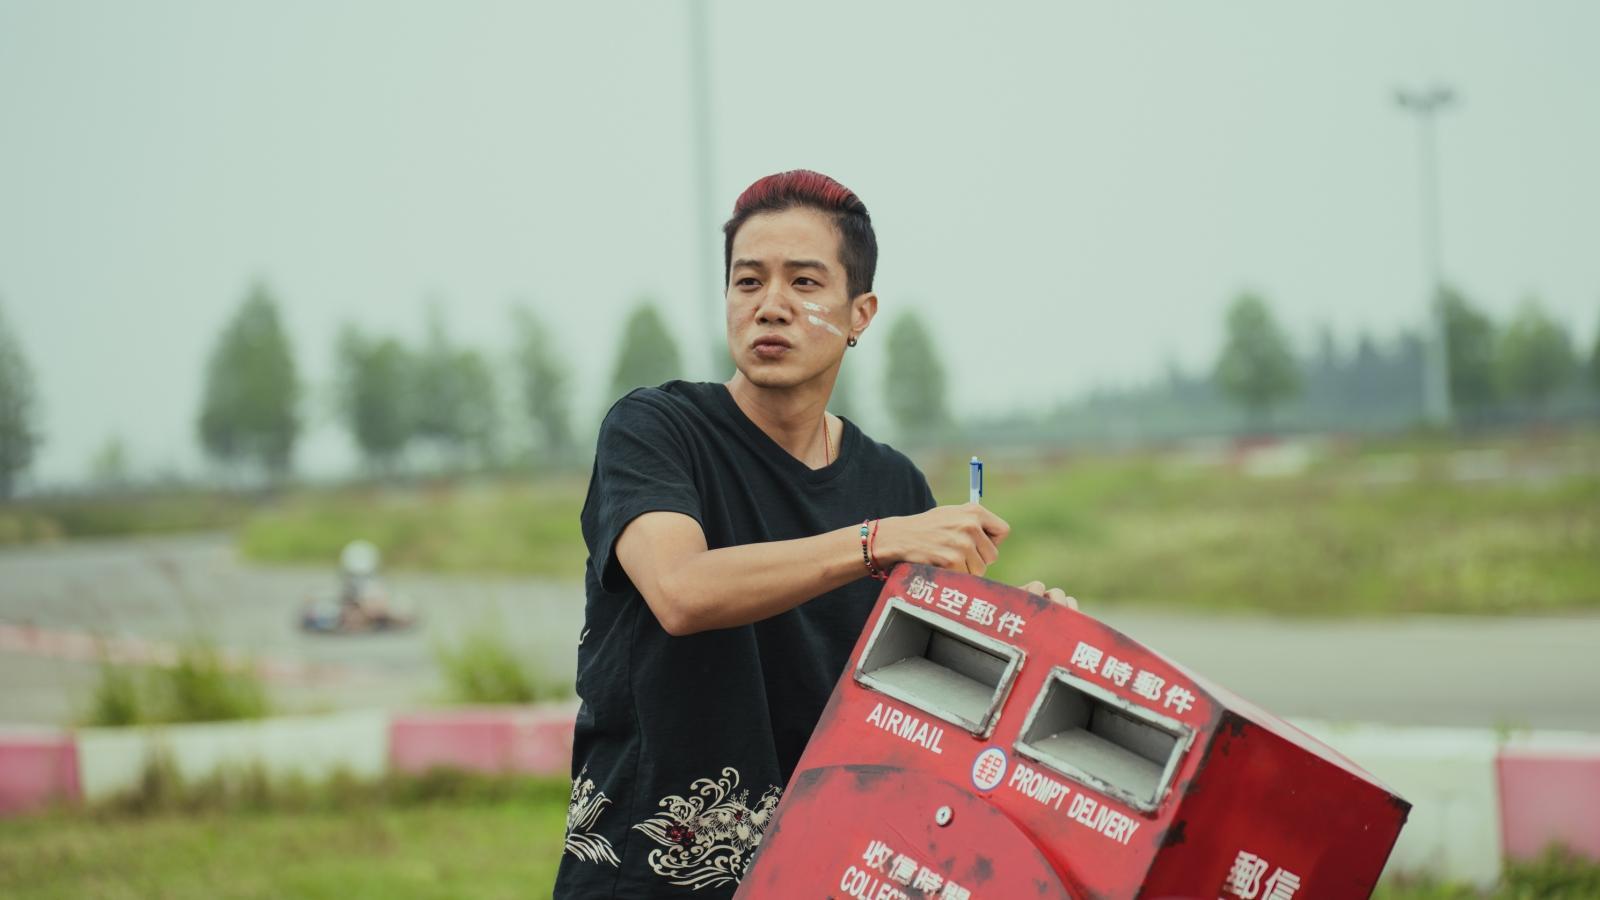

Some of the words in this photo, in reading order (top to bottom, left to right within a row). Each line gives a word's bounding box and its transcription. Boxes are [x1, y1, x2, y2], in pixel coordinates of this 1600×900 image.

[906, 575, 1026, 637] 航空郵件
[1070, 641, 1195, 714] 限時郵件
[866, 702, 944, 754] AIRMAIL
[1008, 763, 1070, 811] PROMPT
[1067, 793, 1140, 845] DELIVERY
